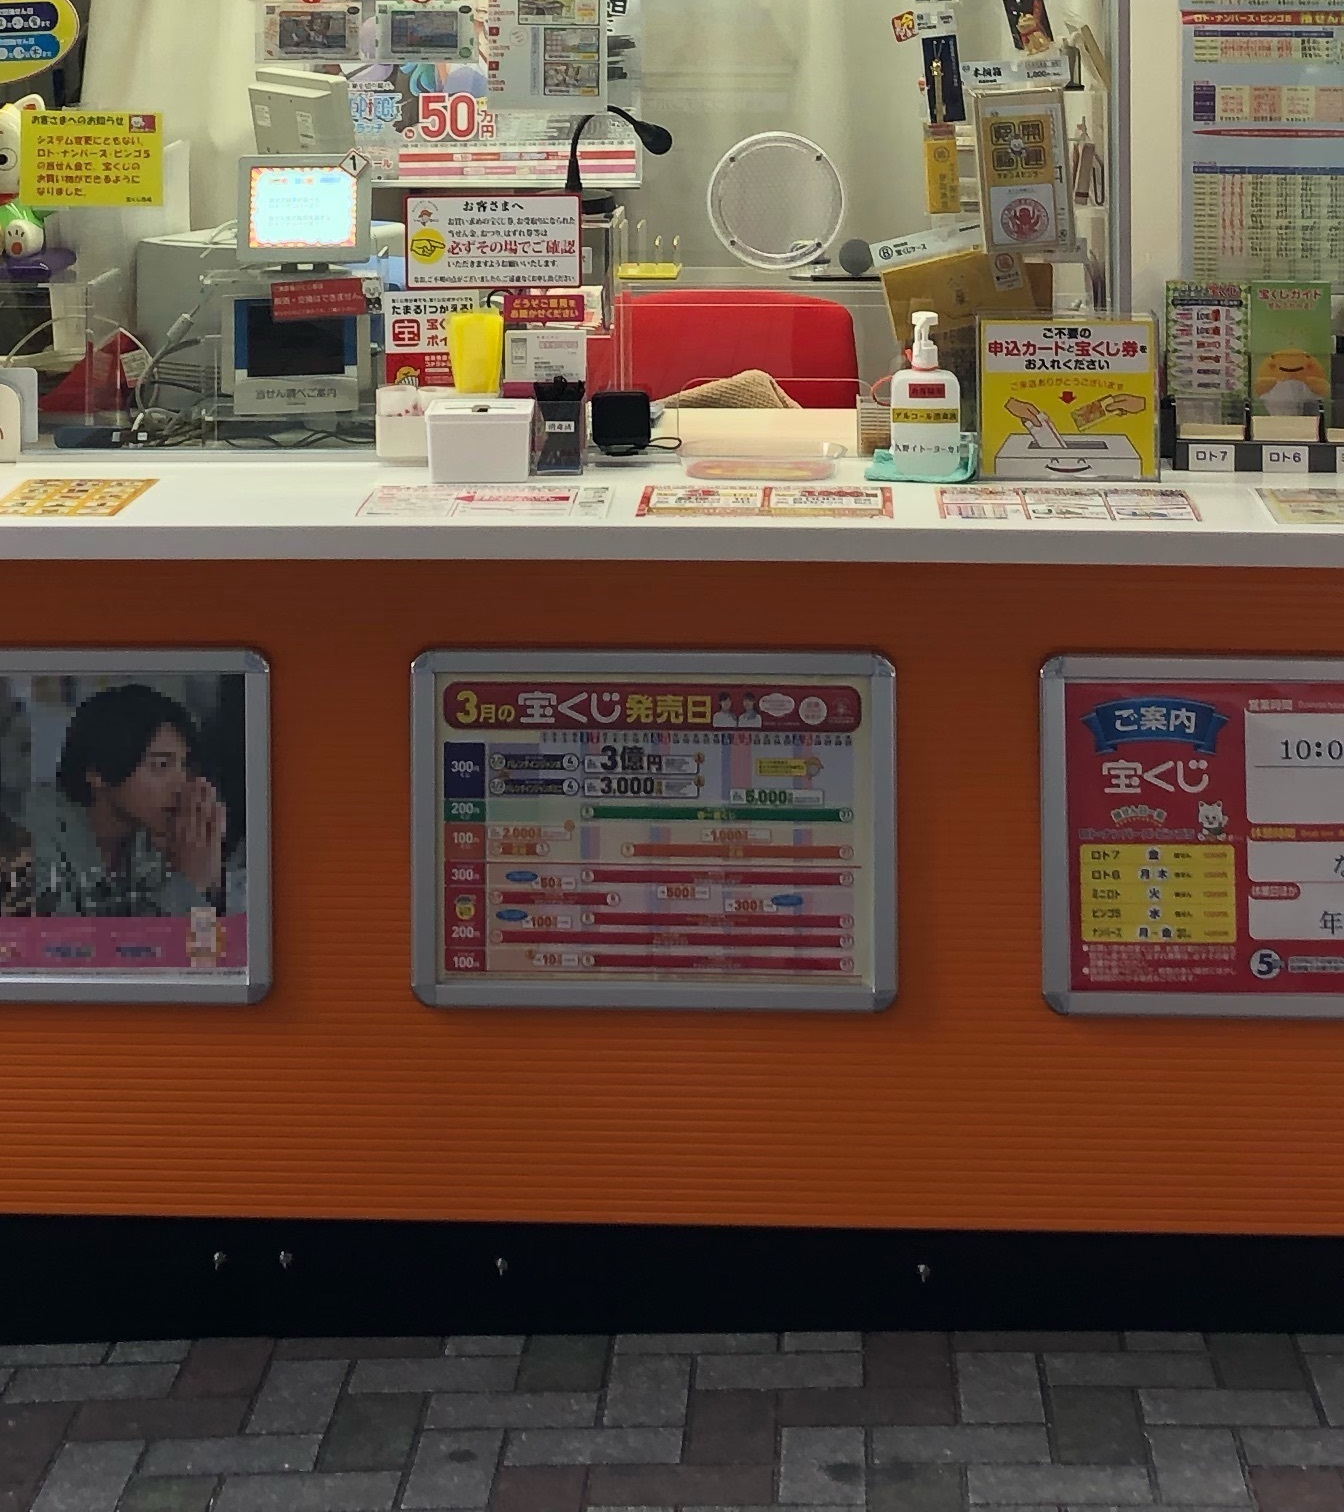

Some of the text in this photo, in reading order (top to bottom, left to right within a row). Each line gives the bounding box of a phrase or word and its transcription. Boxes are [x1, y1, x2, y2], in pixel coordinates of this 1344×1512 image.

[420, 93, 476, 140] 50
[350, 154, 357, 171] 1
[463, 200, 525, 213] お客さまへ
[447, 239, 576, 255] 必ずその場でご確認
[1042, 327, 1092, 339] ご不要の
[988, 341, 1148, 358] 申込カードと宝くじ券を
[1024, 358, 1110, 371] お入れください
[1196, 450, 1228, 463] ロト7
[1269, 450, 1302, 463] ロト6
[457, 690, 712, 724] 3月の宝くじ発売日
[1114, 707, 1196, 734] ご案内
[601, 745, 662, 773] 3億円
[1102, 759, 1210, 794] 宝くじ
[1091, 850, 1120, 860] ロト7
